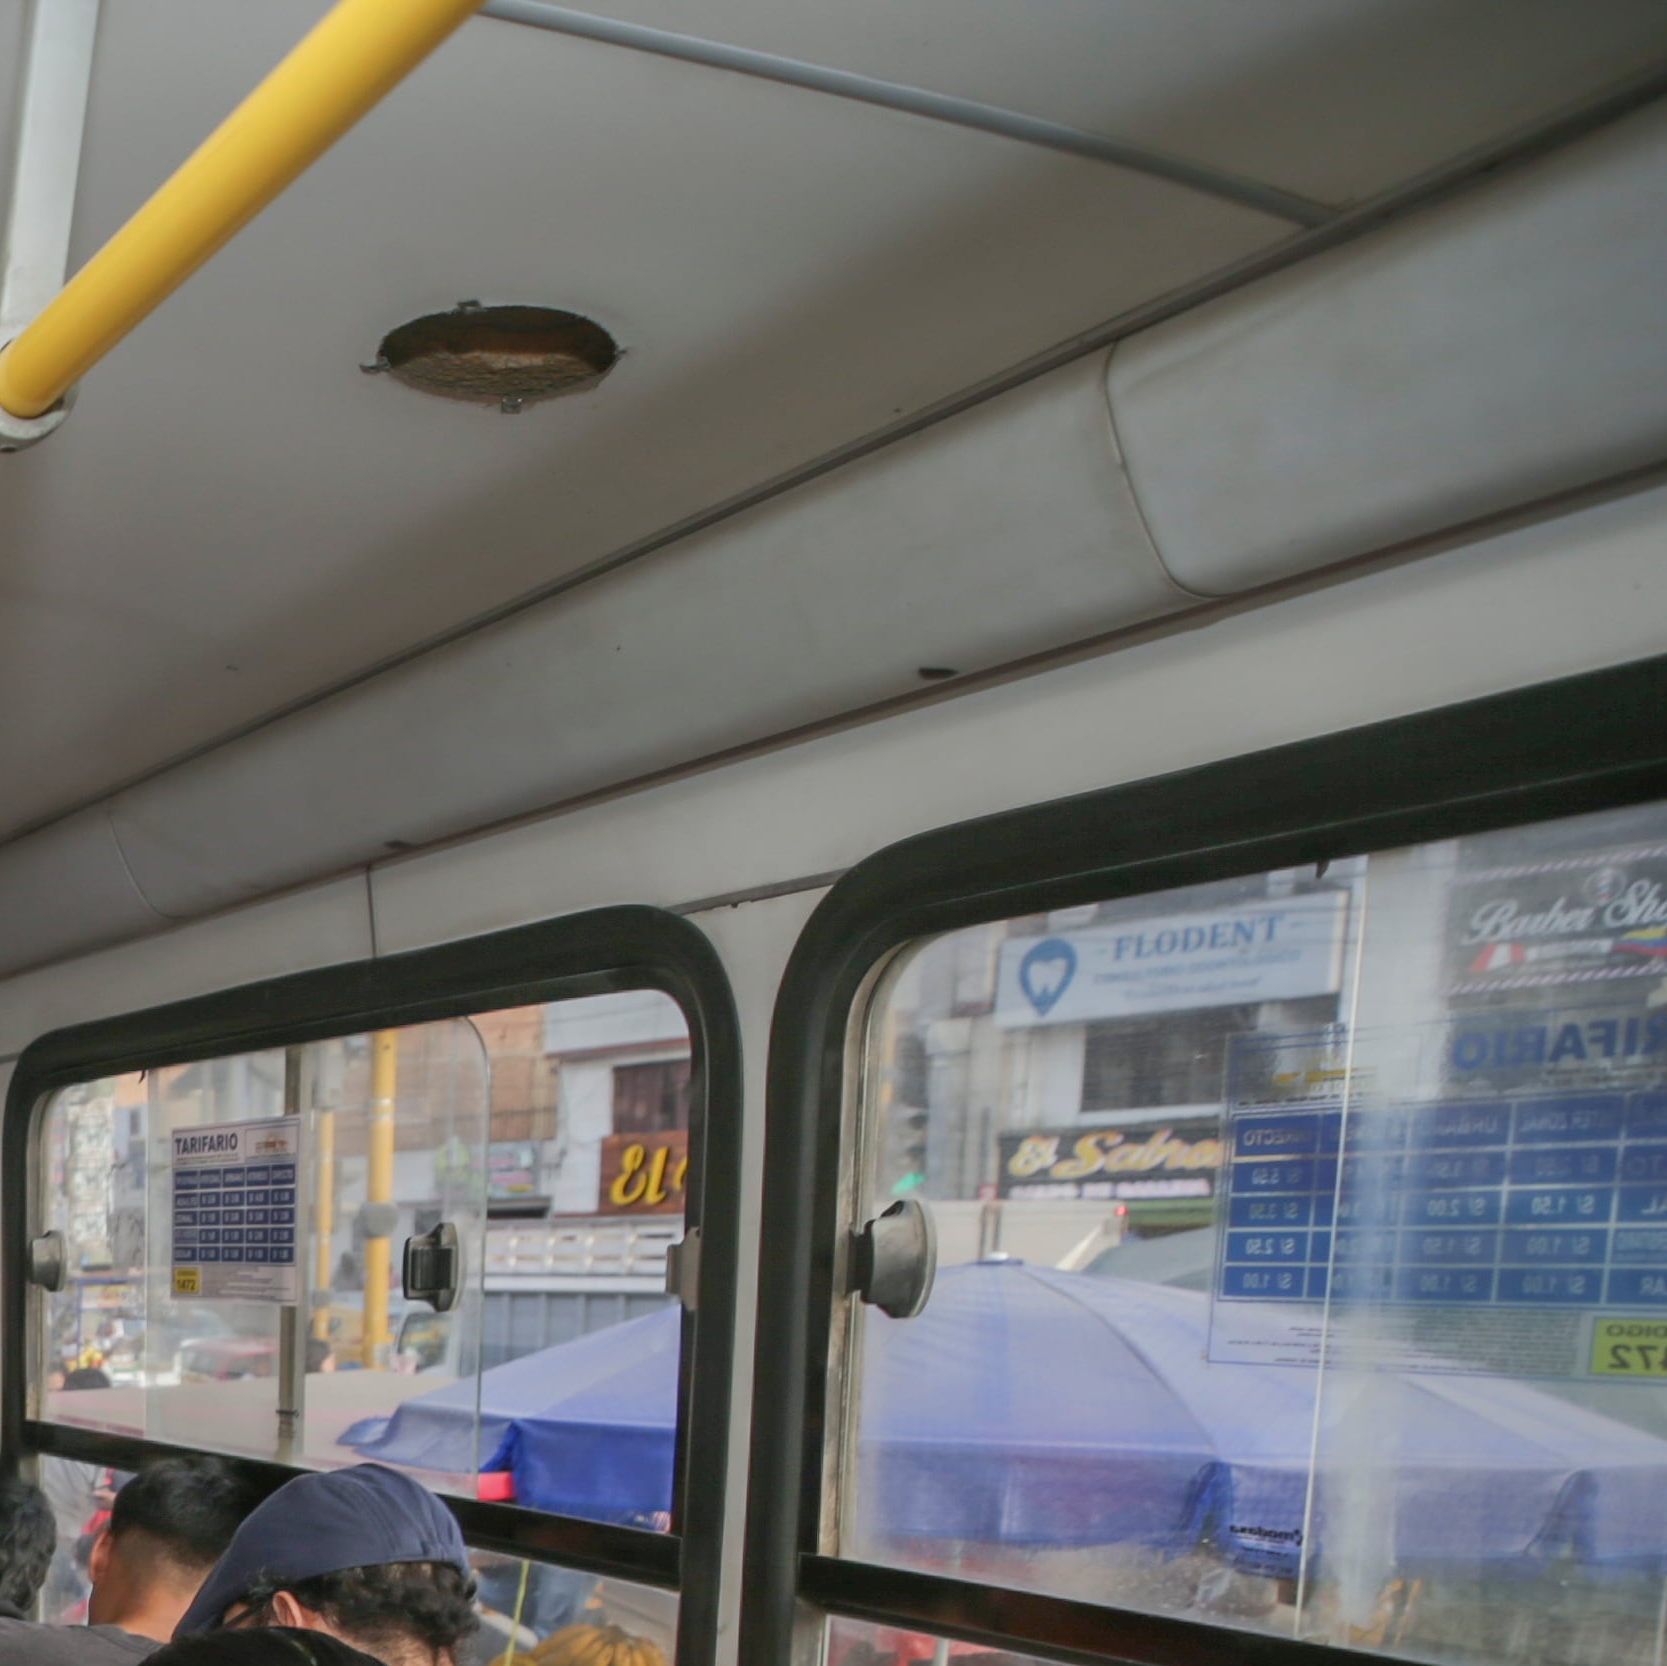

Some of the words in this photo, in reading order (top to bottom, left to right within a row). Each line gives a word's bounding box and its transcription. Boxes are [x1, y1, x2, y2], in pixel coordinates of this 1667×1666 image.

[1113, 915, 1286, 960] FLODENT
[1462, 897, 1595, 946] Barber
[175, 1133, 238, 1154] TARIFARIO
[610, 1144, 670, 1205] El
[176, 1279, 196, 1292] 1472
